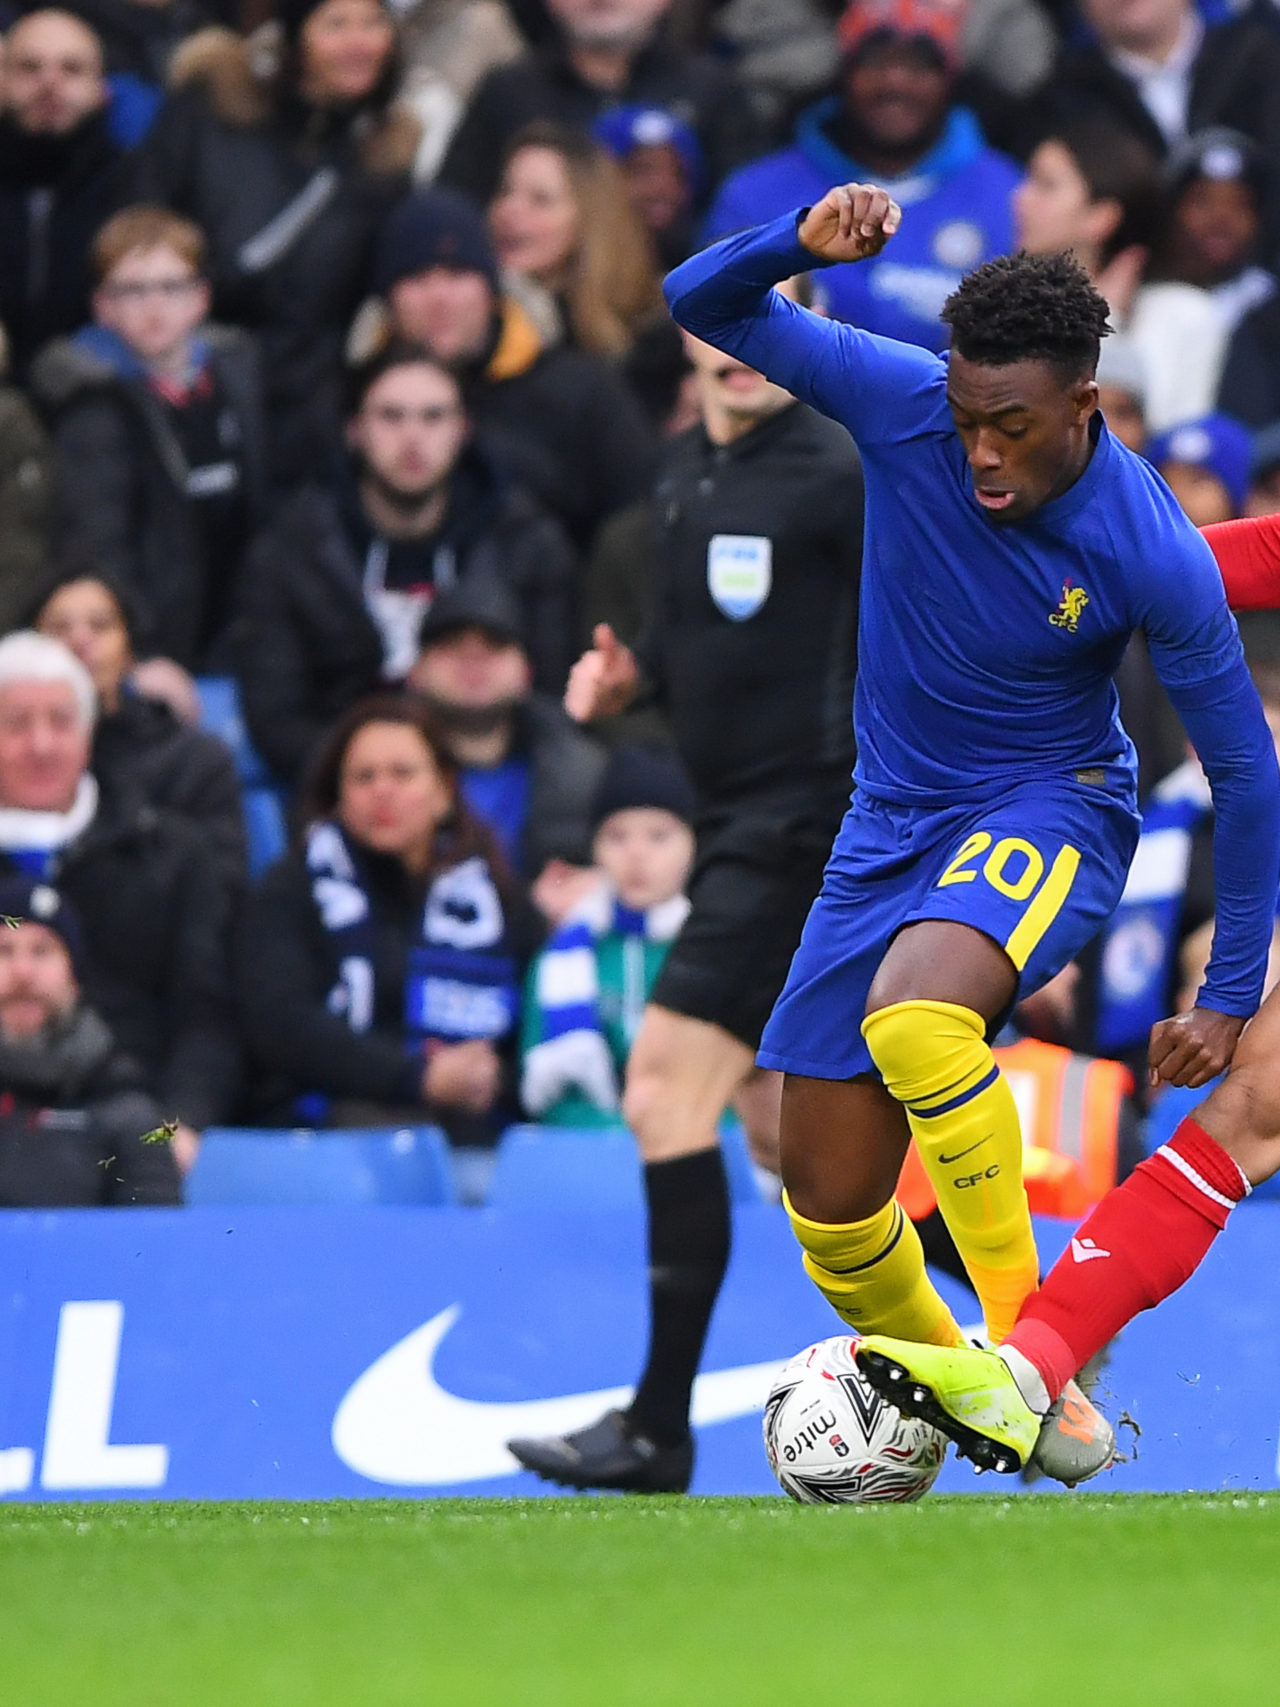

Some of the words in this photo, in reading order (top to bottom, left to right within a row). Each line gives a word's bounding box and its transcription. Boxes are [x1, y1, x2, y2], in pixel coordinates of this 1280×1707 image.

[937, 831, 1044, 901] 20
[953, 1164, 1000, 1189] CFC
[0, 1299, 169, 1493] L
[783, 1409, 837, 1462] mitre
